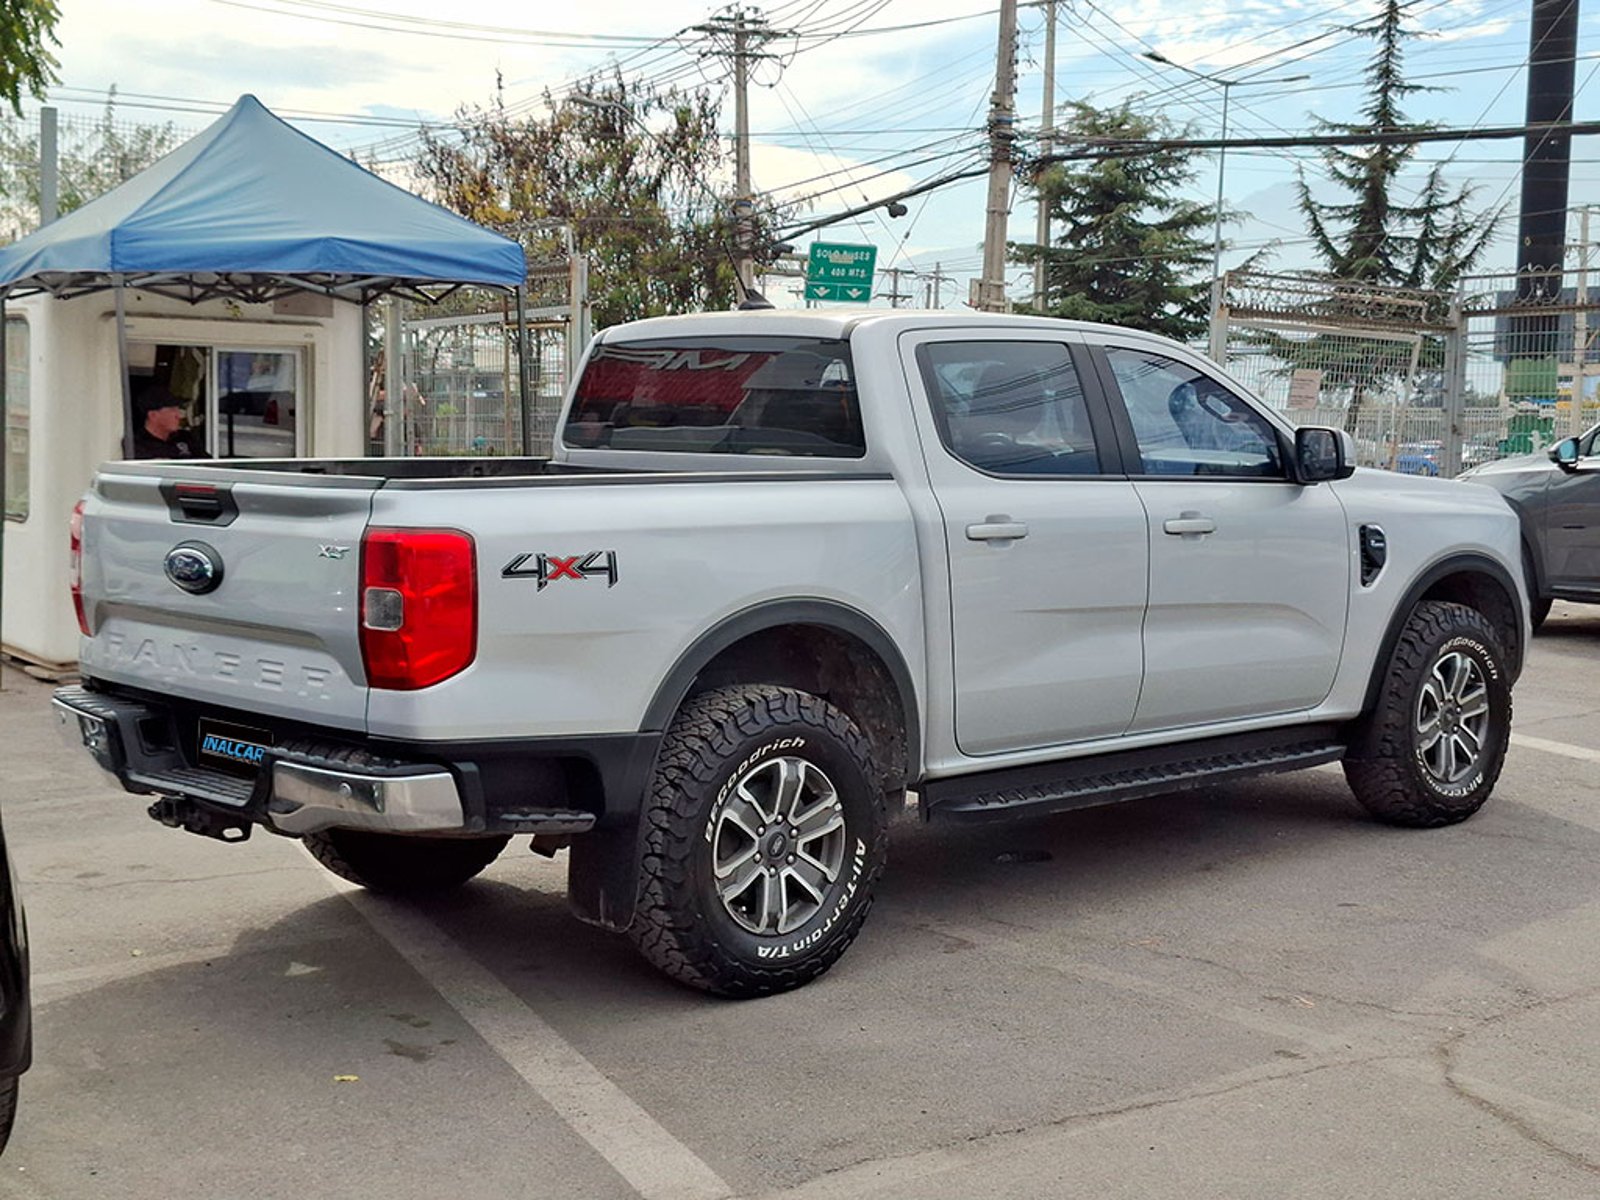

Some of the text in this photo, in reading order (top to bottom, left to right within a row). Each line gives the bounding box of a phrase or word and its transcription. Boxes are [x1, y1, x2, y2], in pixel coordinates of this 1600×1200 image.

[202, 735, 265, 763] INALCAR
[757, 837, 866, 959] All-Terrain T/A
